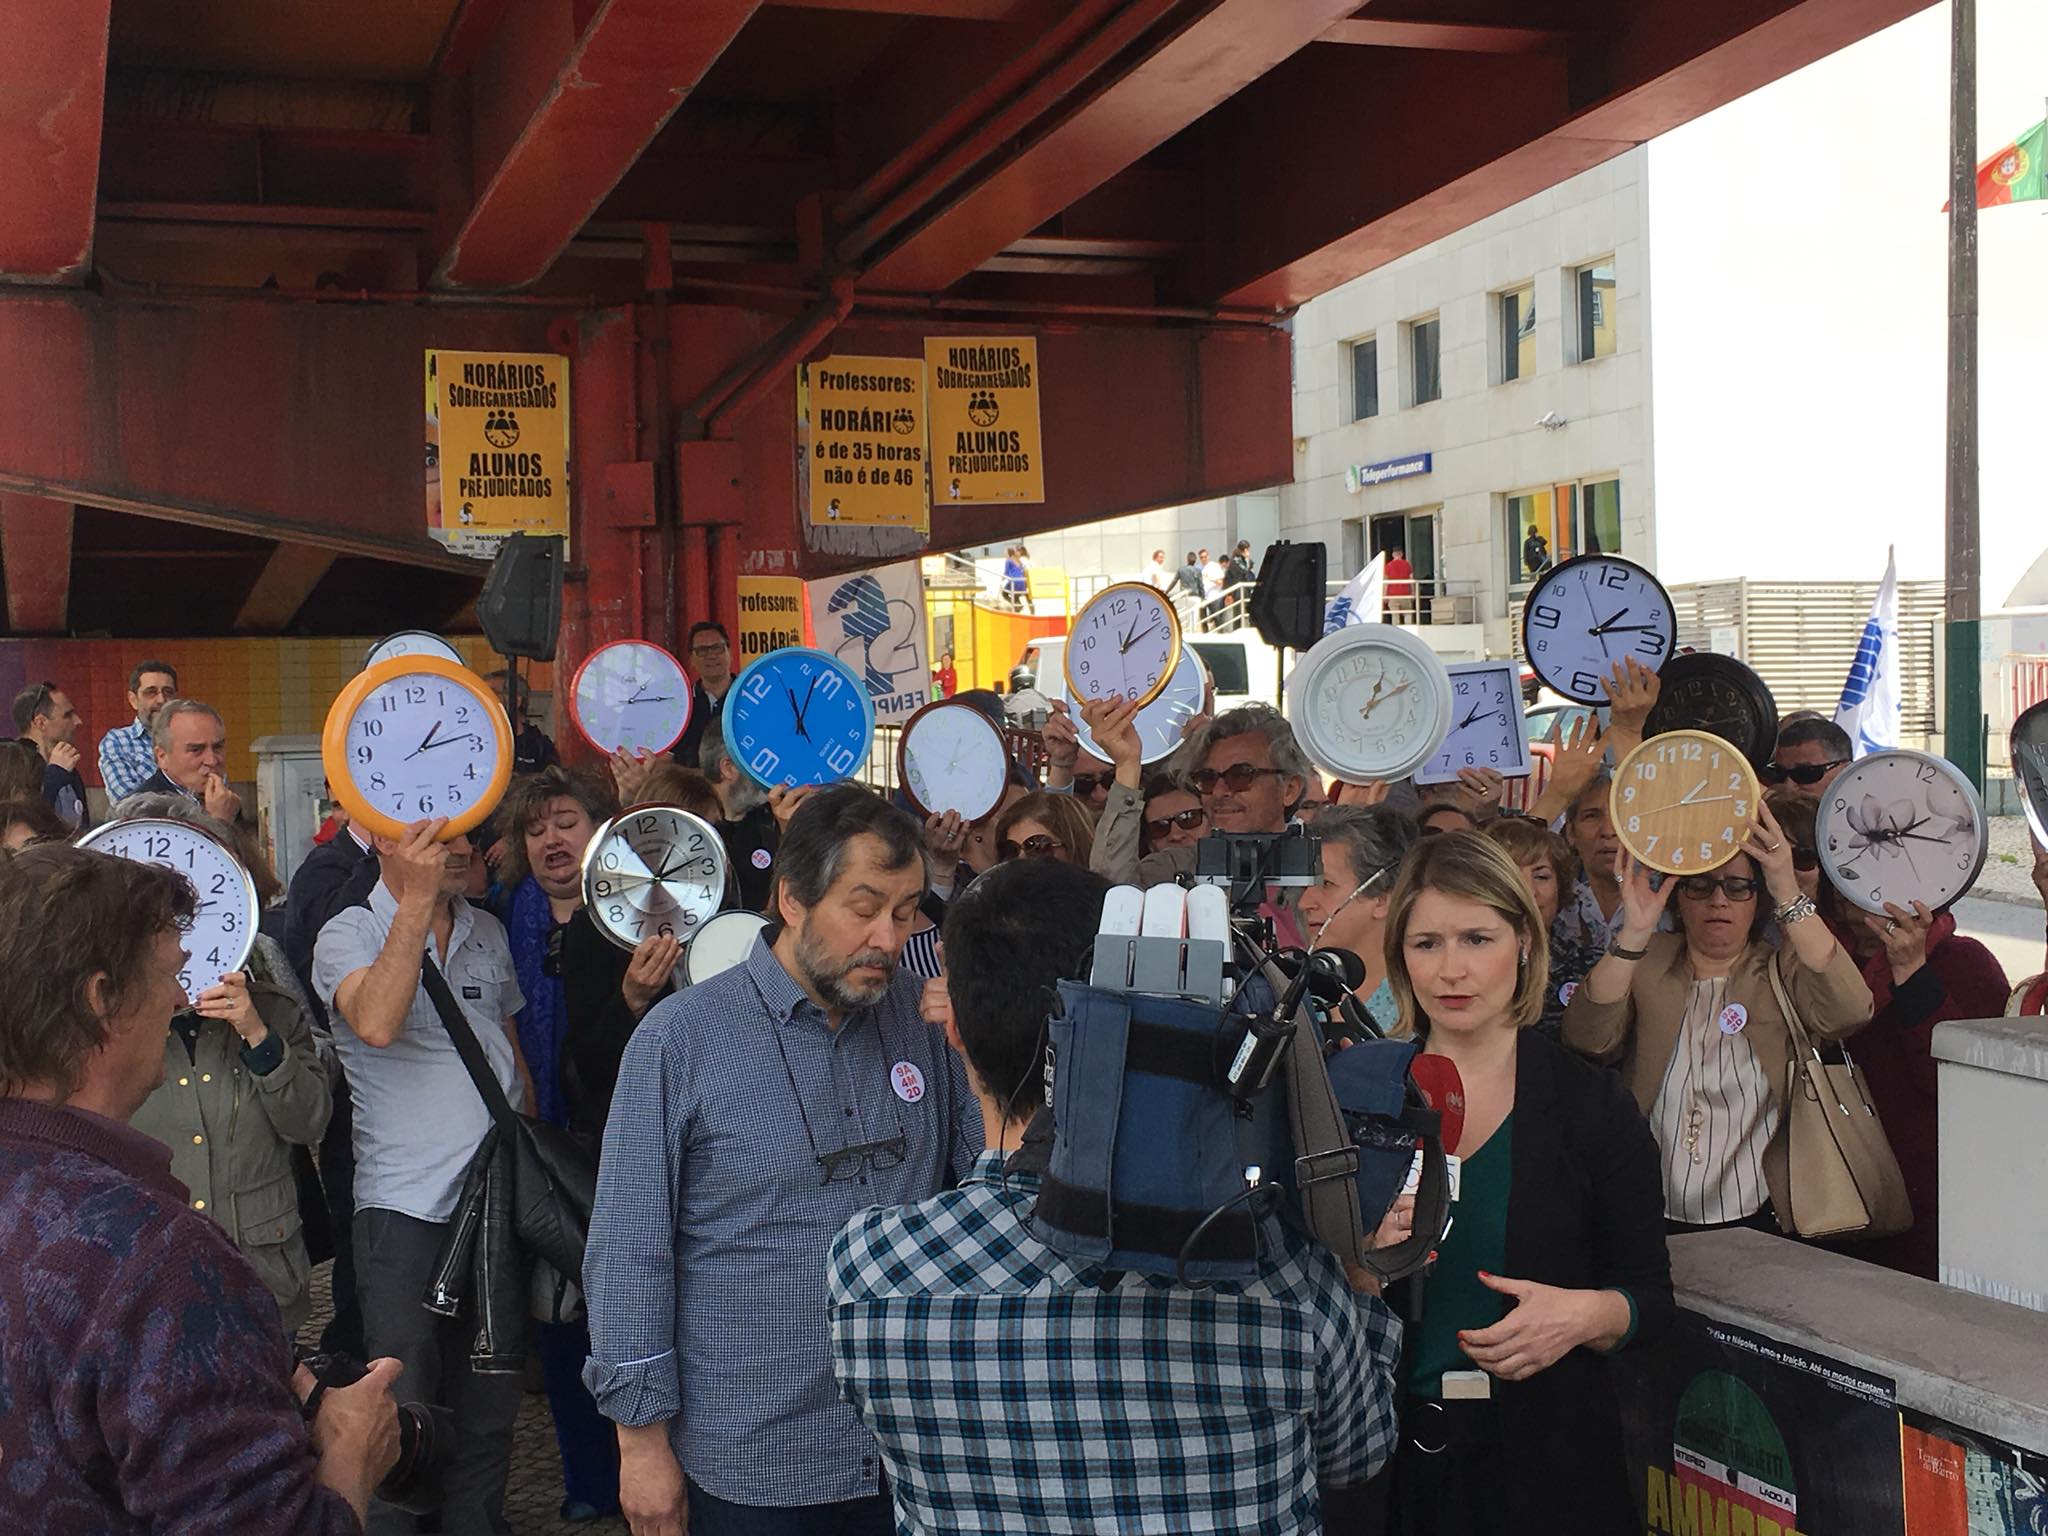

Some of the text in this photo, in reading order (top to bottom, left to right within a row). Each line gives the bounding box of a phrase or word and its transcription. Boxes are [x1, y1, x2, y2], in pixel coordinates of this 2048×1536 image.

[949, 344, 1020, 372] HORÁRIOS
[463, 360, 545, 390] HORÁRIOS
[820, 370, 915, 393] Professores:
[937, 362, 1031, 389] SOBRECARREGADOS
[449, 381, 557, 409] SOBRECARREGADOS
[815, 441, 921, 461] é de 35 horas
[956, 431, 1020, 454] ALUNOS
[469, 452, 543, 477] ALUNOS
[948, 453, 1029, 474] PREJUDICADOS
[824, 466, 913, 486] não é de 46
[1360, 460, 1424, 485] Teleperformance
[459, 477, 552, 499] PREJUDICADOS
[1599, 565, 1630, 591] 12
[1552, 584, 1566, 598] 10
[1639, 583, 1645, 594] 1
[1109, 599, 1127, 616] 12
[1136, 598, 1142, 611] 1
[1092, 614, 1107, 629] 11
[1150, 607, 1161, 622] 2
[1533, 605, 1561, 629] 9
[1649, 609, 1661, 621] 2
[1161, 626, 1171, 640] 3
[1081, 636, 1096, 651] 10
[1536, 640, 1548, 652] 8
[1635, 630, 1666, 656] 3
[1159, 651, 1168, 664] 4
[772, 665, 782, 674] 1
[800, 663, 812, 676] 2
[1079, 661, 1090, 675] 9
[1553, 666, 1563, 676] 7
[813, 669, 843, 701] 3
[1090, 680, 1100, 693] 8
[1147, 672, 1157, 687] 5
[1455, 681, 1469, 695] 12
[1481, 681, 1486, 693] 1
[1571, 671, 1599, 696] 6
[405, 686, 426, 704] 12
[742, 673, 772, 705] 12
[1127, 687, 1138, 701] 6
[381, 695, 398, 712] 11
[437, 690, 445, 706] 1
[846, 699, 857, 711] 4
[1495, 692, 1504, 704] 2
[456, 706, 469, 724] 2
[1498, 713, 1507, 726] 3
[362, 719, 383, 737] 10
[848, 729, 860, 741] 5
[469, 735, 484, 753] 3
[741, 735, 755, 750] 10
[1501, 735, 1509, 747] 4
[357, 745, 373, 764] 9
[827, 744, 855, 774] 6
[1465, 752, 1475, 764] 6
[1489, 750, 1498, 763] 5
[1657, 746, 1676, 764] 11
[1681, 743, 1702, 760] 12
[751, 747, 780, 778] 9
[1442, 754, 1451, 767] 7
[1711, 752, 1720, 769] 1
[463, 763, 477, 780] 4
[814, 772, 824, 784] 7
[1635, 764, 1656, 780] 10
[1915, 762, 1937, 784] 12
[370, 771, 386, 791] 8
[784, 774, 797, 787] 8
[1729, 773, 1741, 790] 2
[392, 792, 405, 811] 7
[448, 784, 462, 802] 5
[1624, 787, 1636, 803] 9
[419, 794, 434, 813] 6
[1734, 800, 1746, 817] 3
[1835, 798, 1846, 814] 9
[635, 816, 658, 835] 12
[671, 818, 679, 835] 1
[1627, 816, 1641, 833] 8
[613, 829, 630, 847] 11
[688, 834, 704, 852] 2
[1721, 827, 1734, 844] 4
[144, 837, 171, 858] 12
[1644, 836, 1659, 855] 7
[1700, 843, 1713, 860] 5
[185, 848, 195, 868] 1
[597, 853, 618, 871] 10
[1672, 847, 1684, 864] 6
[1957, 853, 1971, 870] 3
[701, 857, 716, 876] 3
[210, 873, 225, 894] 2
[595, 880, 611, 898] 9
[699, 884, 712, 901] 4
[1870, 887, 1882, 901] 6
[221, 912, 236, 933] 3
[610, 905, 625, 923] 8
[684, 908, 698, 926] 5
[631, 920, 645, 938] 7
[658, 922, 674, 938] 6
[206, 946, 220, 966] 4
[178, 970, 192, 990] 5
[896, 1064, 912, 1077] 9A
[906, 1086, 921, 1099] 2D
[1809, 1362, 1822, 1373] Até
[1822, 1368, 1831, 1377] os
[1832, 1371, 1856, 1386] mortos
[1675, 1449, 1706, 1469] STEREO
[1759, 1486, 1791, 1506] LADO A
